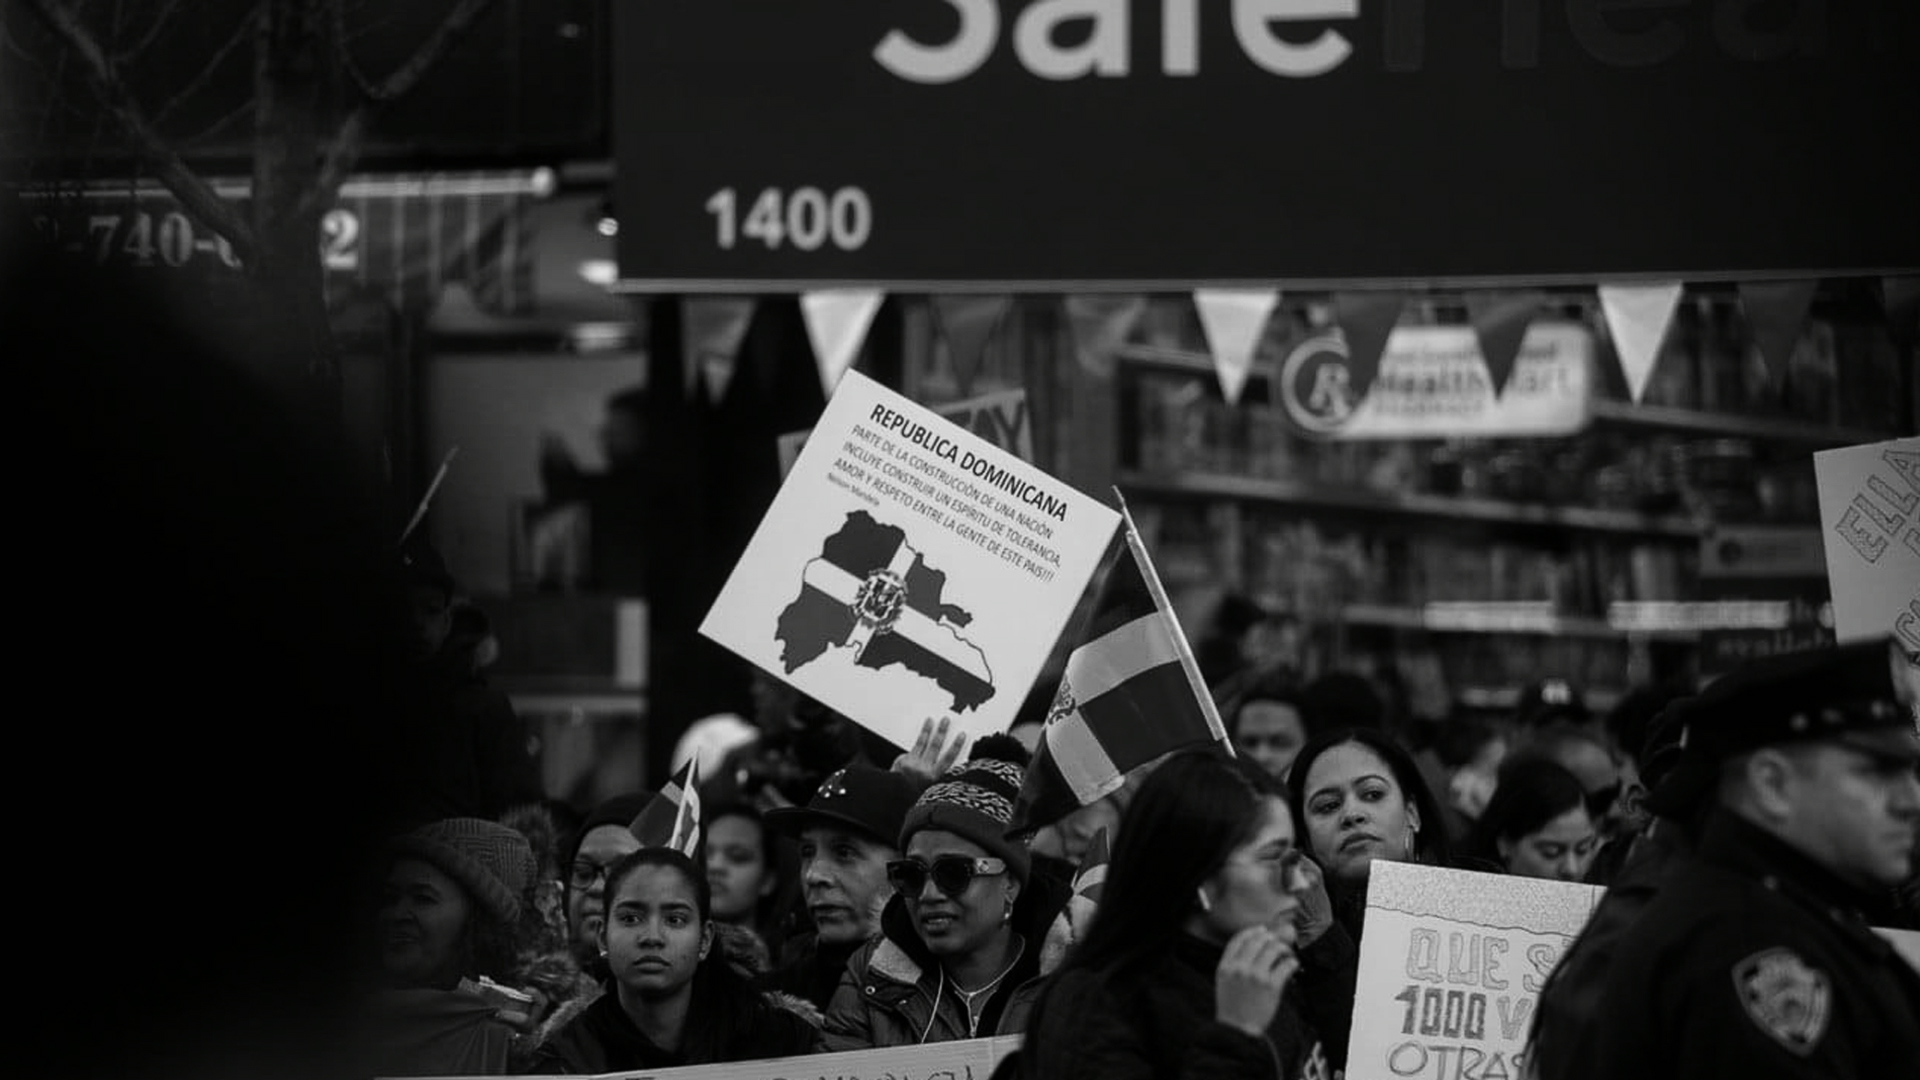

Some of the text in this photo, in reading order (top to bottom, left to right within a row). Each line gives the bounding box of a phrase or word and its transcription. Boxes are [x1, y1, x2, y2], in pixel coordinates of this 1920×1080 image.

[704, 185, 873, 251] 1400
[843, 441, 882, 470] INCLUYE
[883, 463, 936, 498] CONSTRUIR
[935, 491, 953, 506] UN
[991, 520, 1006, 535] DE
[852, 424, 882, 448] PARTE
[881, 440, 896, 456] DE
[896, 448, 909, 462] LA
[980, 493, 996, 509] DE
[994, 500, 1016, 520] UNA
[1016, 511, 1054, 539] NACIÓN
[870, 403, 1068, 521] REPUBLICA DOMINICANA
[833, 457, 865, 481] AMOR
[865, 473, 874, 485] Y
[871, 477, 914, 508] RESPETO
[912, 499, 944, 525] ENTRE
[943, 516, 956, 531] LA
[956, 522, 988, 548] GENTE
[986, 539, 1001, 555] DE
[1000, 547, 1024, 568] ESTE
[1406, 927, 1510, 990] QUE
[1395, 985, 1487, 1040] 1000
[1389, 1042, 1526, 1080] OTRA
